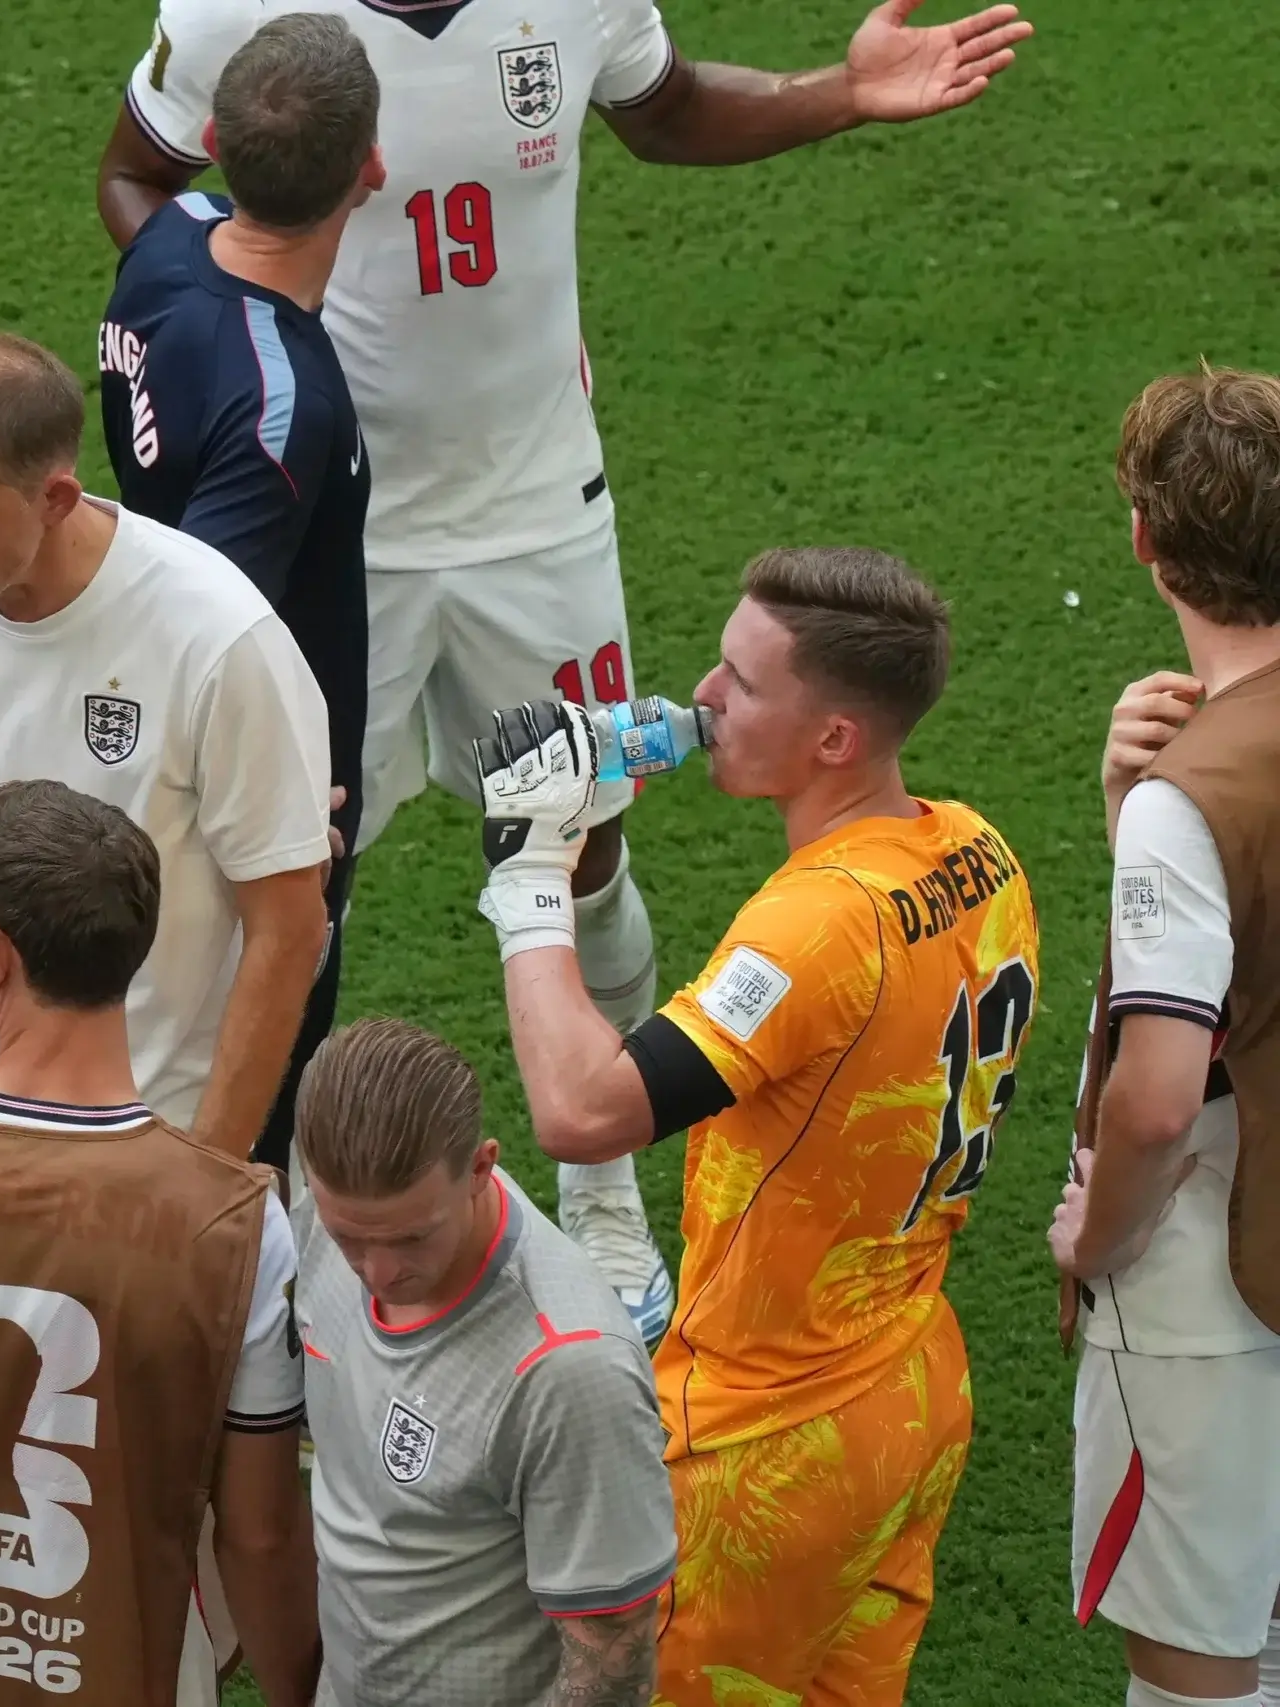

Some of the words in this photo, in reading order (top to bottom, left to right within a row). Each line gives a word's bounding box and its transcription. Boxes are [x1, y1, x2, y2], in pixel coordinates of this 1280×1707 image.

[516, 132, 557, 154] FRANCE
[404, 181, 498, 296] 19
[1121, 876, 1154, 889] FOOTBALL
[535, 894, 561, 909] DH
[1122, 888, 1155, 905] UNITES
[727, 971, 767, 1004] UNITES
[736, 960, 773, 992] FOOTBALL
[718, 1000, 735, 1016] FIFA
[728, 991, 759, 1018] World
[21, 1609, 85, 1643] CUP
